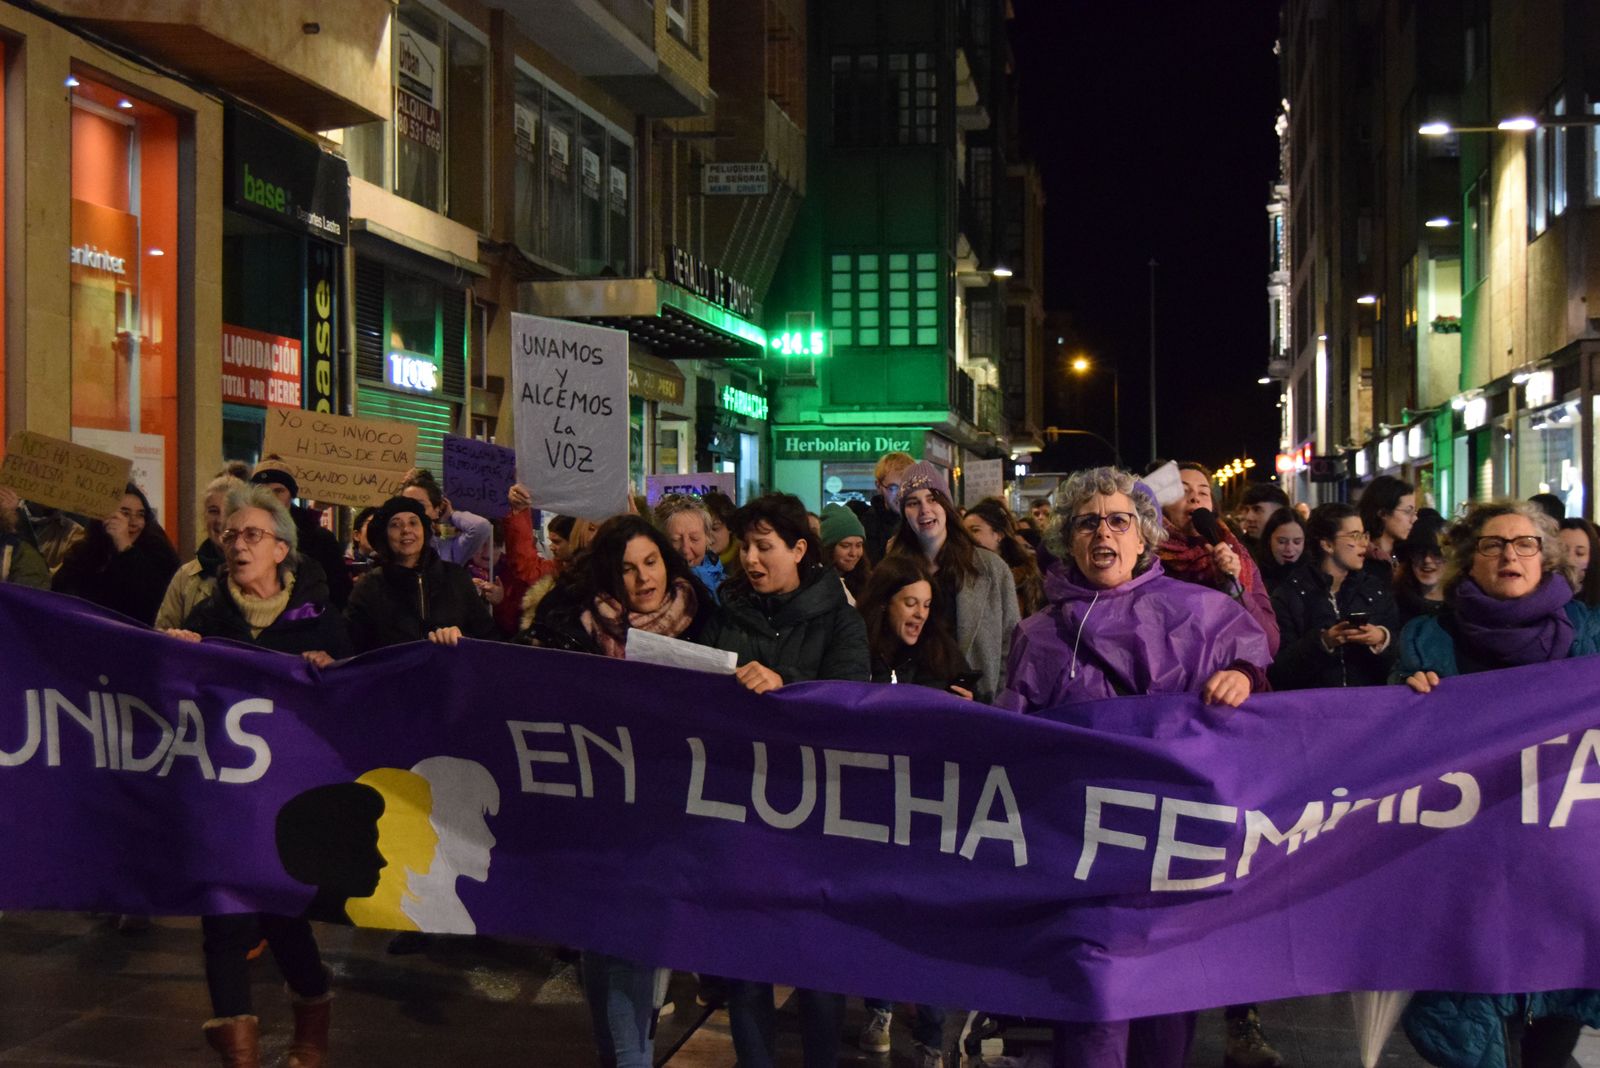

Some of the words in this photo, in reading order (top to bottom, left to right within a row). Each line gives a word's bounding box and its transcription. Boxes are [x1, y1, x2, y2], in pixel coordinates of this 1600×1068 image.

[398, 92, 436, 128] ALQUILA
[713, 267, 725, 306] DE
[223, 333, 298, 377] LIQUIDACIÓN
[522, 333, 604, 365] UNAMOS
[222, 374, 246, 398] TOTAL
[249, 378, 265, 400] POR
[268, 377, 300, 406] CIERRE
[278, 409, 302, 429] YO
[312, 420, 338, 434] OS
[343, 425, 404, 445] INVOCO
[355, 450, 374, 461] DE
[380, 449, 409, 464] EVA
[544, 438, 594, 473] VOZ
[785, 437, 871, 453] Herbolario
[874, 437, 910, 452] Diez
[352, 473, 378, 486] UNA
[506, 719, 636, 804] EN
[685, 737, 1028, 867] LUCHA
